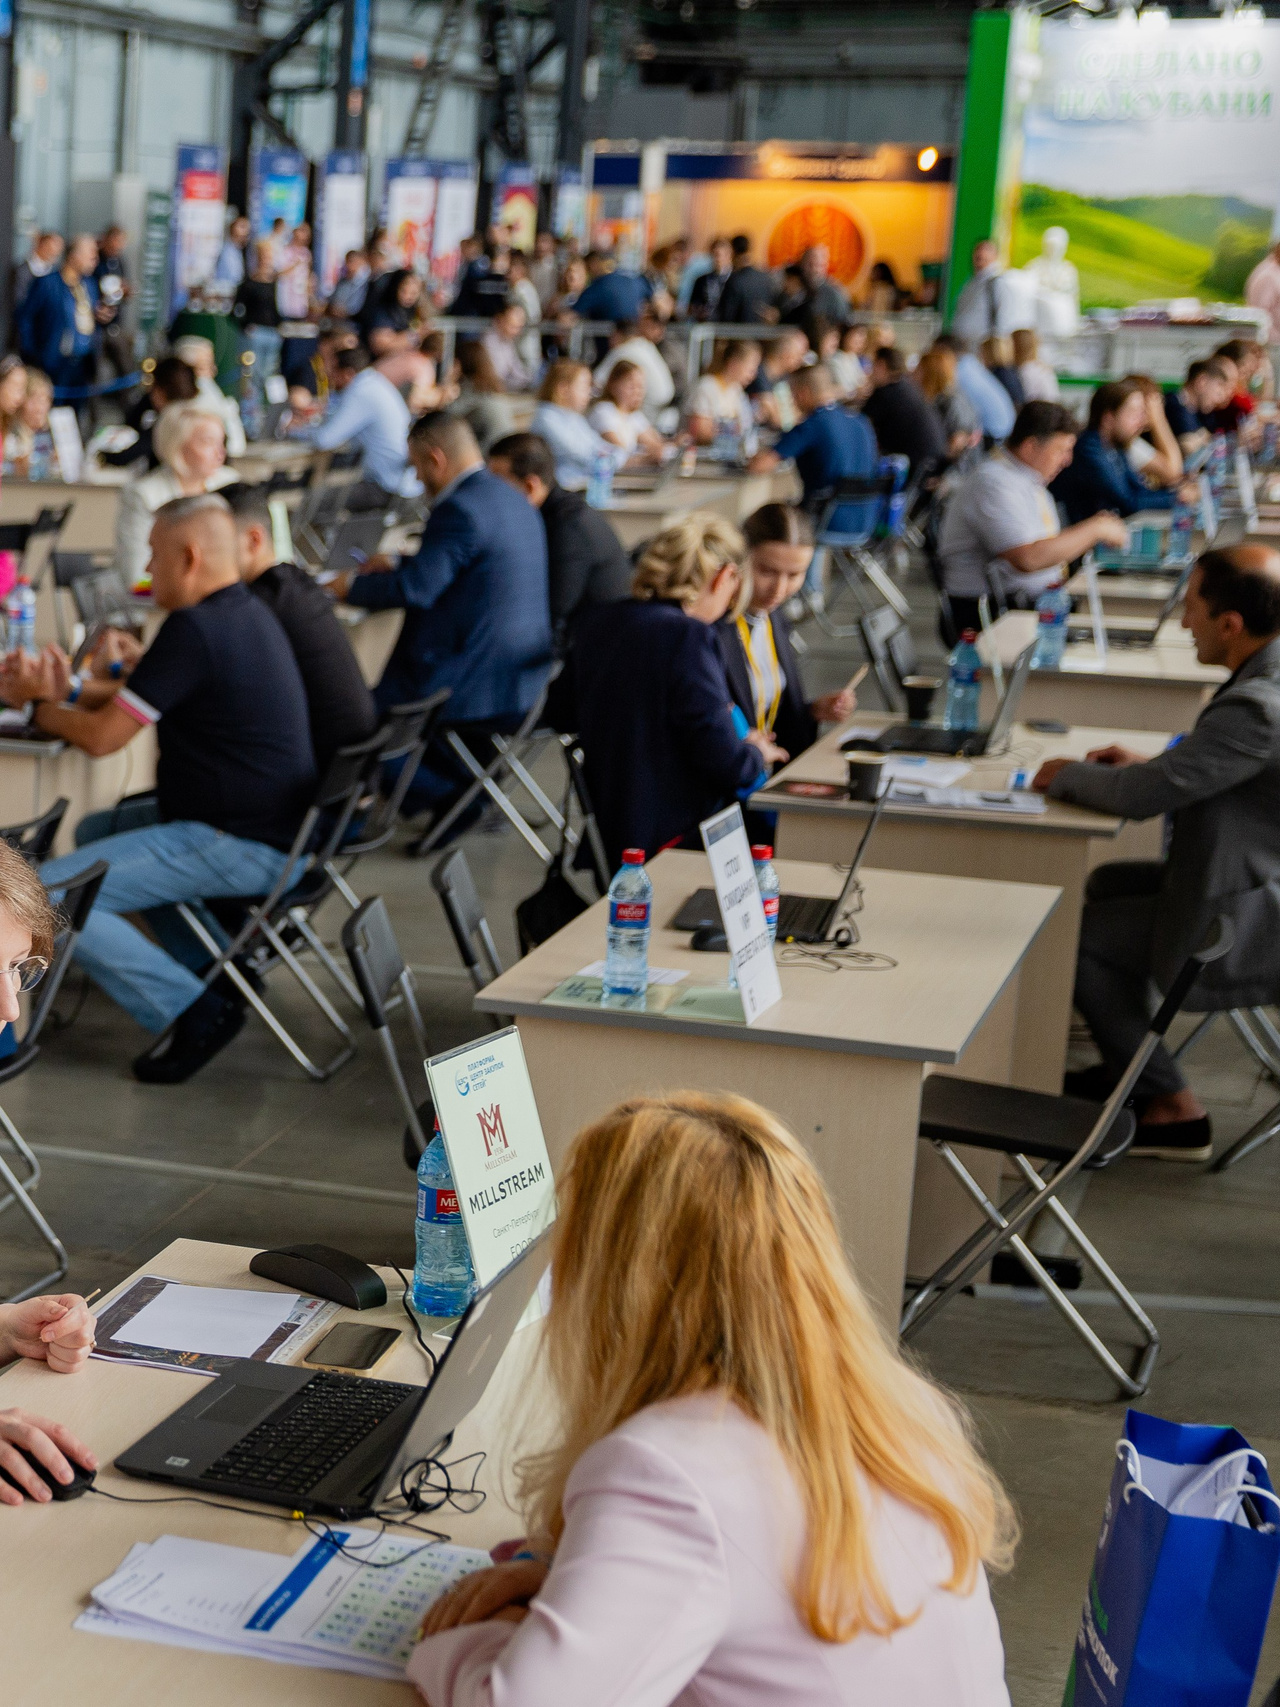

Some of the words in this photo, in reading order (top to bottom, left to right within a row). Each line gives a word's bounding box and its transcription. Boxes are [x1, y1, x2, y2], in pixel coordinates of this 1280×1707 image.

[1118, 84, 1274, 120] КУБАНИ
[467, 1054, 495, 1072] ПЛАТФОРМА
[469, 1069, 484, 1082] ЦЕНТР
[484, 1060, 505, 1075] ЗАКУПОК
[468, 1162, 546, 1215] MILLSTREAM
[492, 1208, 541, 1239] Санкт-Петербург
